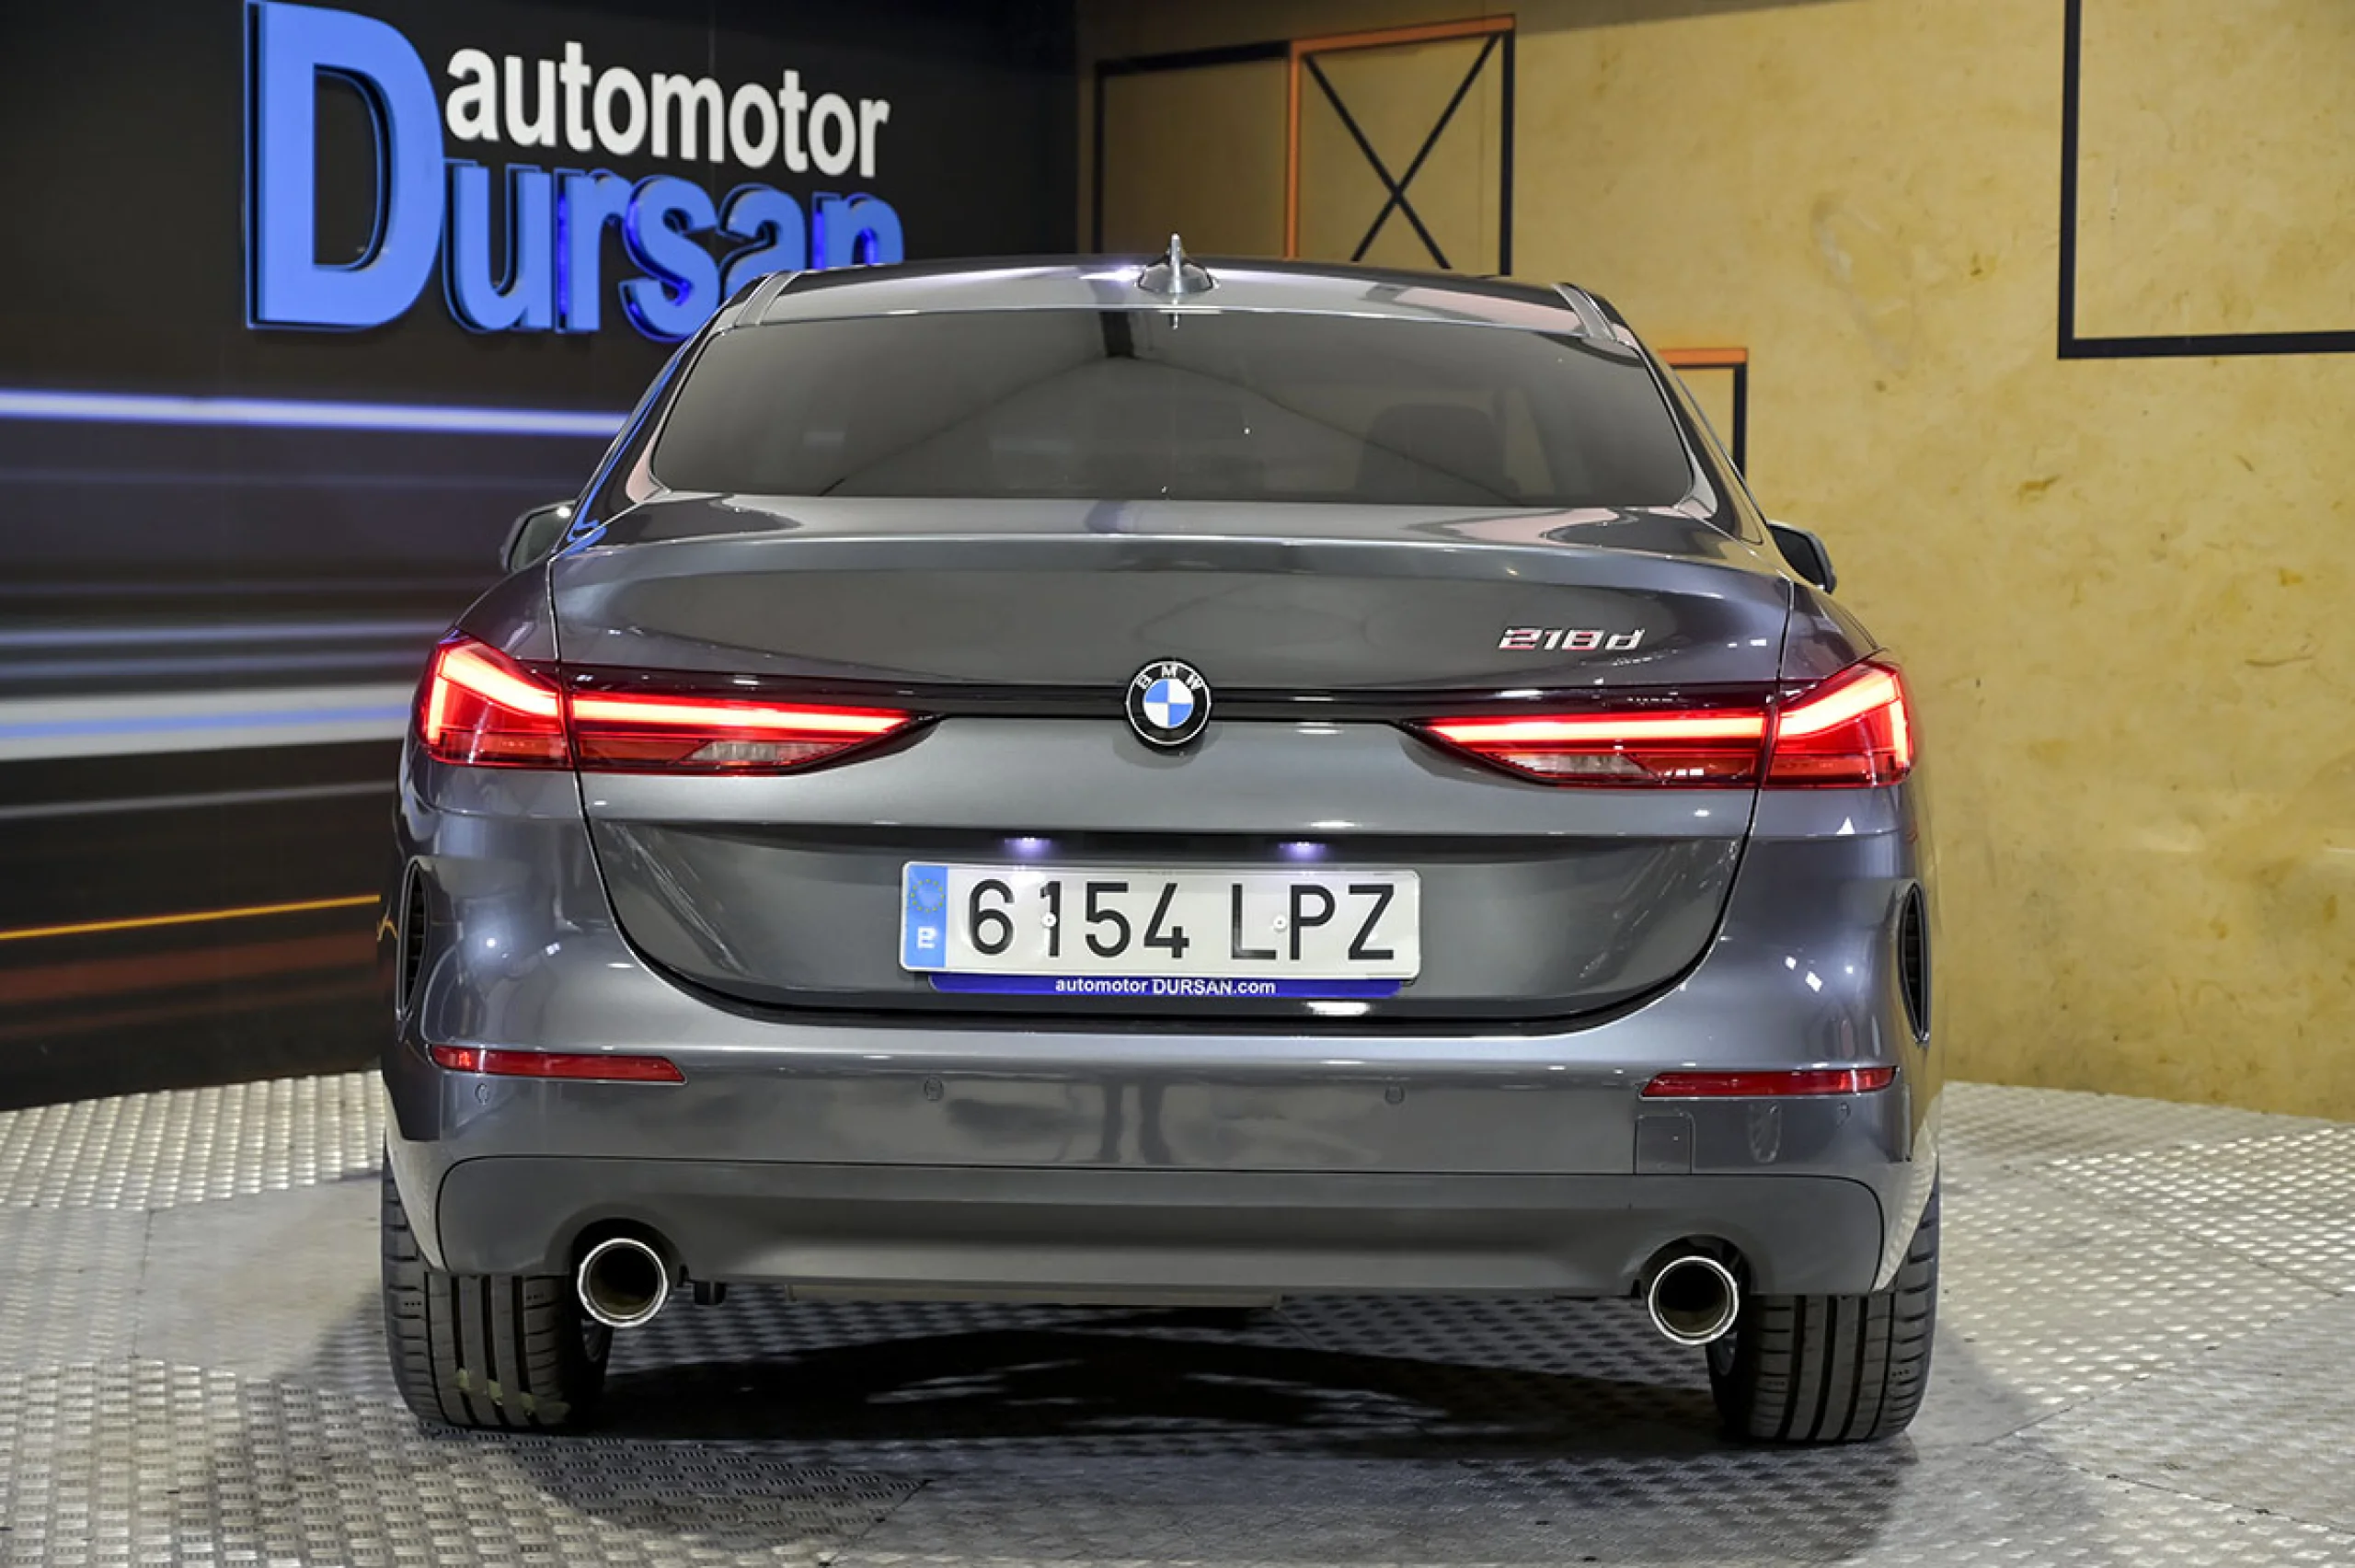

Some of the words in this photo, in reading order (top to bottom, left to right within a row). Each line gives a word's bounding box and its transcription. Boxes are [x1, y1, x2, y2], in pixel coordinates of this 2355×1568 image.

[446, 41, 890, 178] automotor
[245, 0, 905, 342] Dursan
[1499, 628, 1645, 650] 218d
[1134, 662, 1204, 690] BMW
[969, 878, 1189, 958] 6154
[1231, 882, 1394, 961] LPZ
[1055, 977, 1148, 993] automotor
[1152, 978, 1276, 996] DURSAN.com
